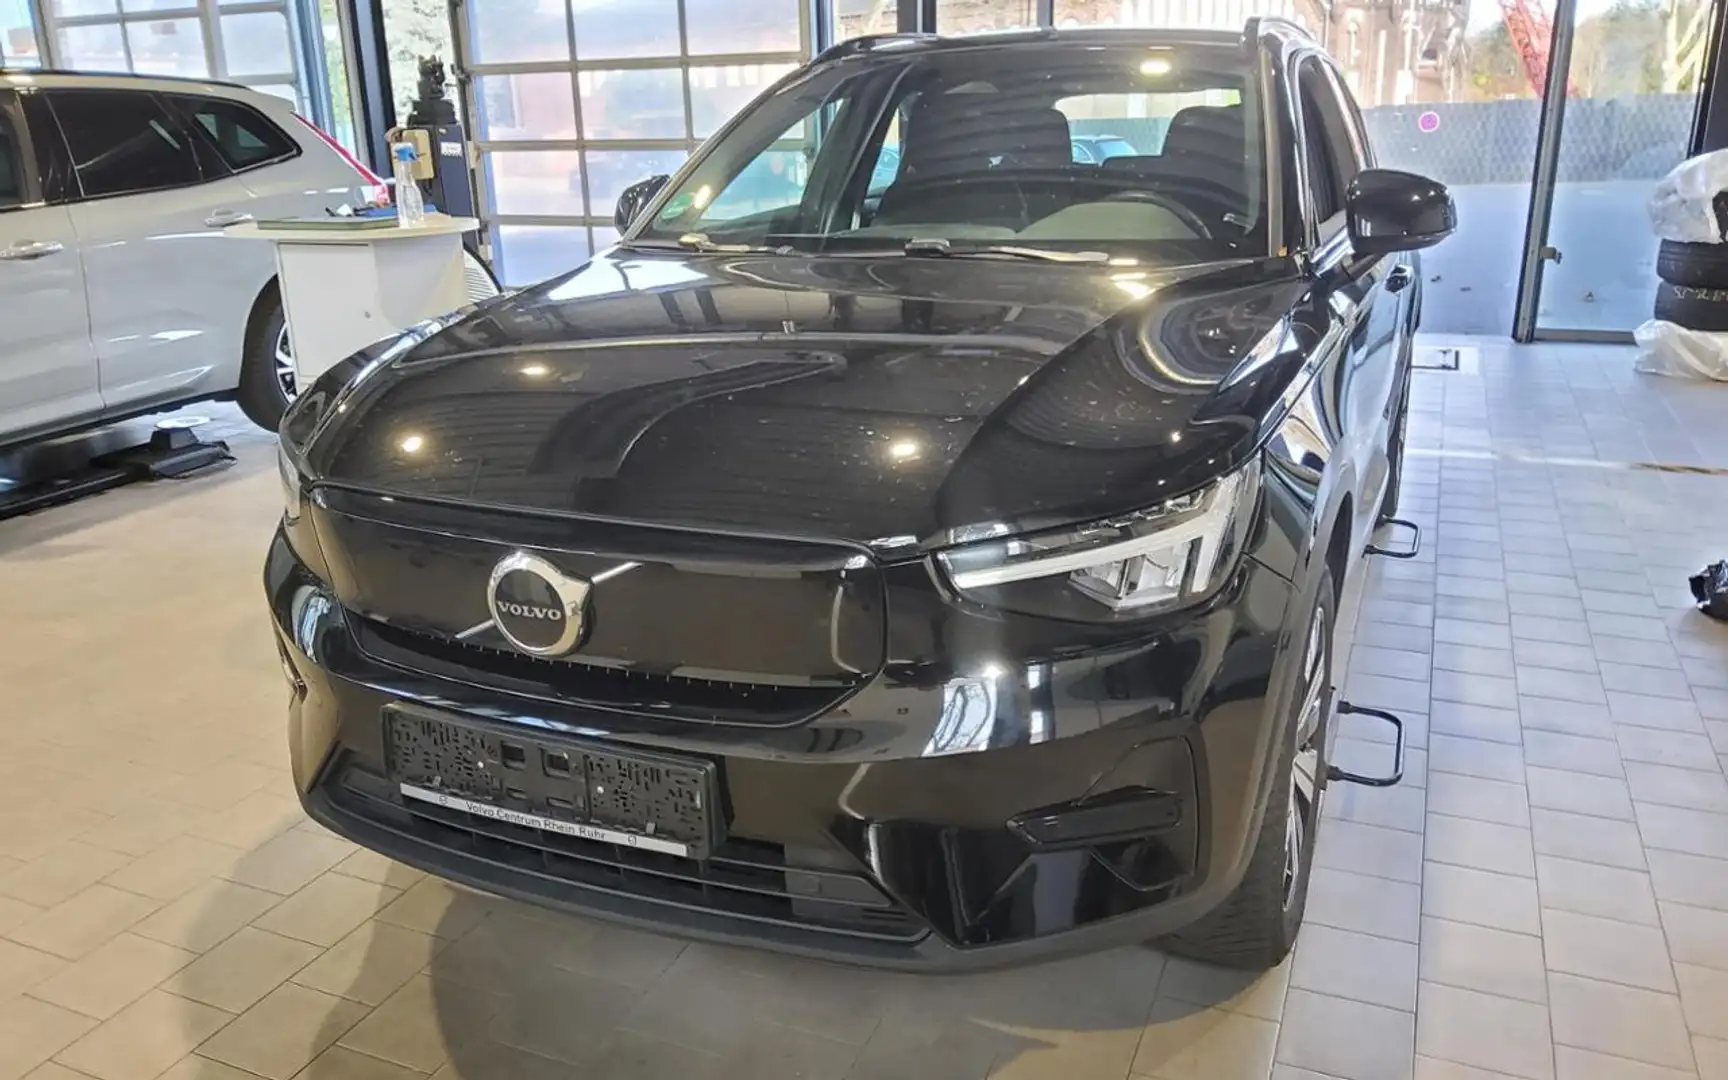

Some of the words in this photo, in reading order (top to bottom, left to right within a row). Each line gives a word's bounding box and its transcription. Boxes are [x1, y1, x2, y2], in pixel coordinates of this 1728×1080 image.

[496, 600, 562, 621] VOLVO
[465, 801, 495, 817] Volvo
[496, 808, 542, 828] Centrum
[544, 819, 575, 834] Rhein
[579, 826, 606, 840] Ruhr
